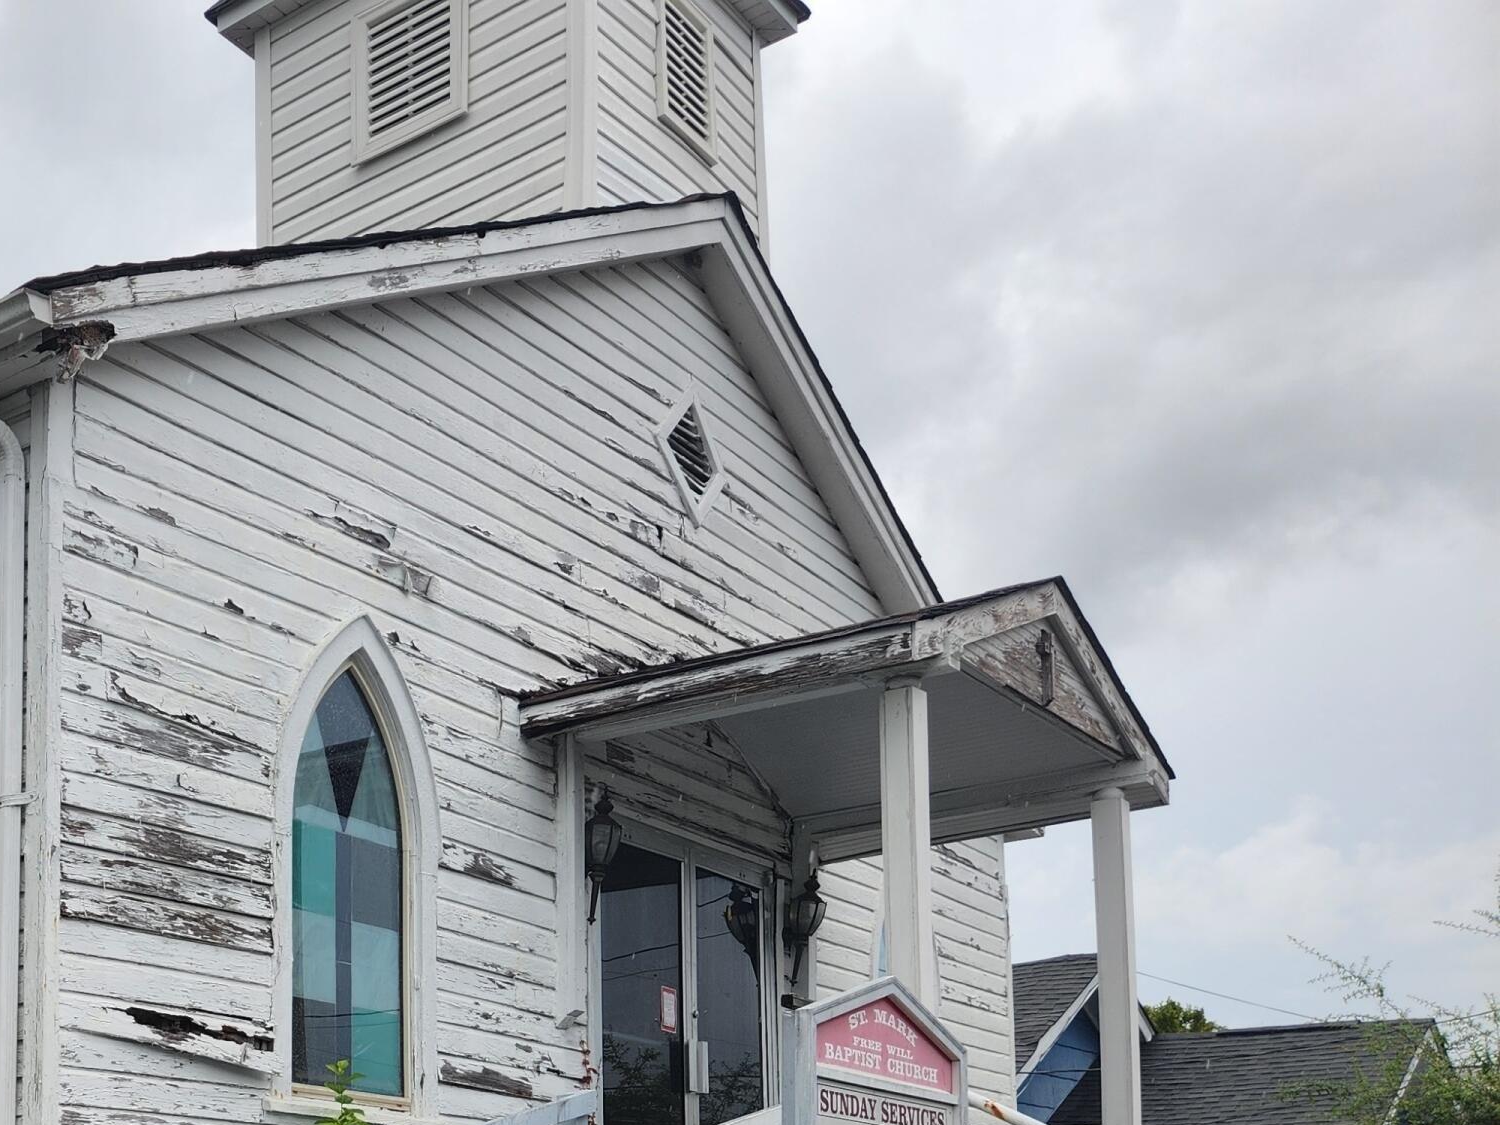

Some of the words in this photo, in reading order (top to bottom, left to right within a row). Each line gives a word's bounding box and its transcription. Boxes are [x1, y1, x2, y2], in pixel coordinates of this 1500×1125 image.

[848, 1010, 868, 1030] ST.
[874, 1008, 918, 1047] MARK
[825, 1042, 881, 1069] BAPTIST
[887, 1058, 938, 1083] CHURCH
[853, 1036, 882, 1051] FREE
[887, 1044, 913, 1060] WILL
[820, 1089, 877, 1120] SUNDAY
